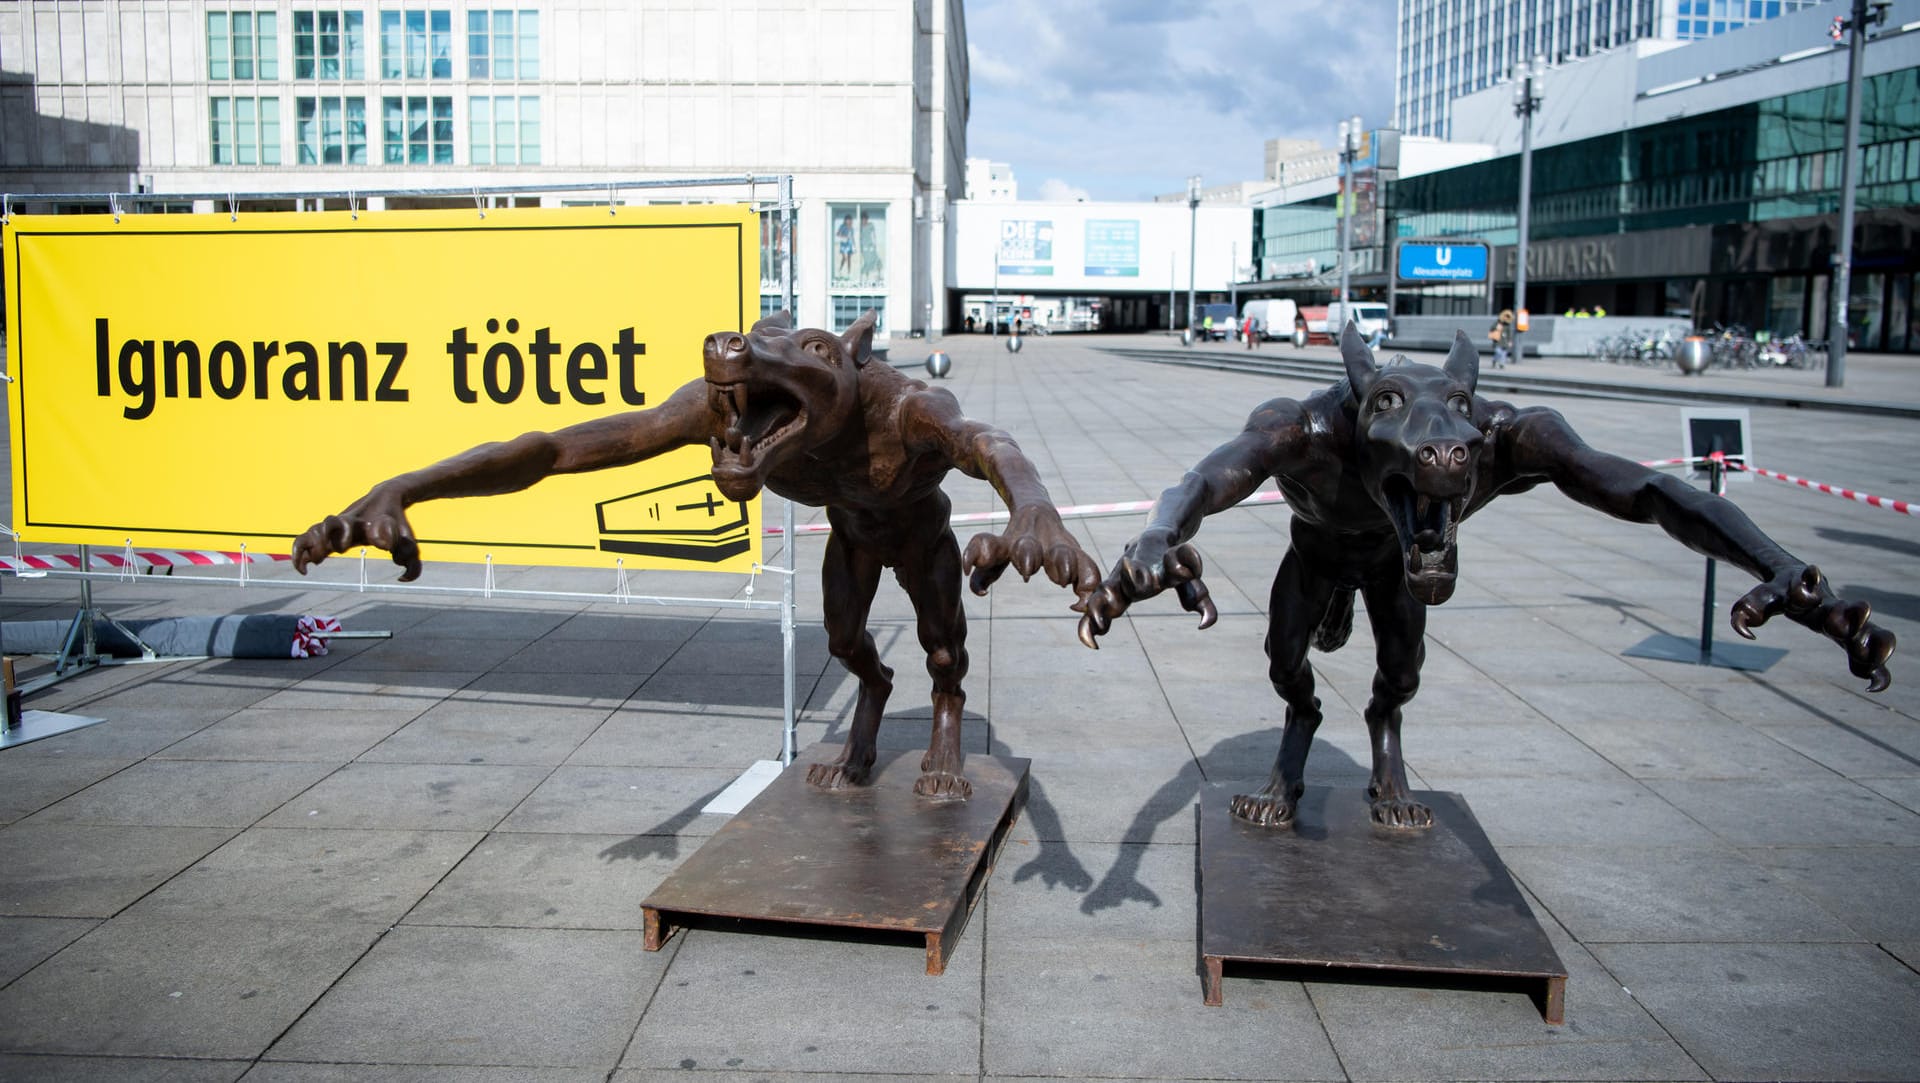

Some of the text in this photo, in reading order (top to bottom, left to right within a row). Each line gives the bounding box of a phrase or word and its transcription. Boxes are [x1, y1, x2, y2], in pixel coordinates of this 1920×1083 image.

[1002, 221, 1036, 239] DIE
[1436, 247, 1452, 266] U
[1412, 267, 1473, 279] Alexanderplatz
[95, 318, 646, 421] Ignoranz tötet
